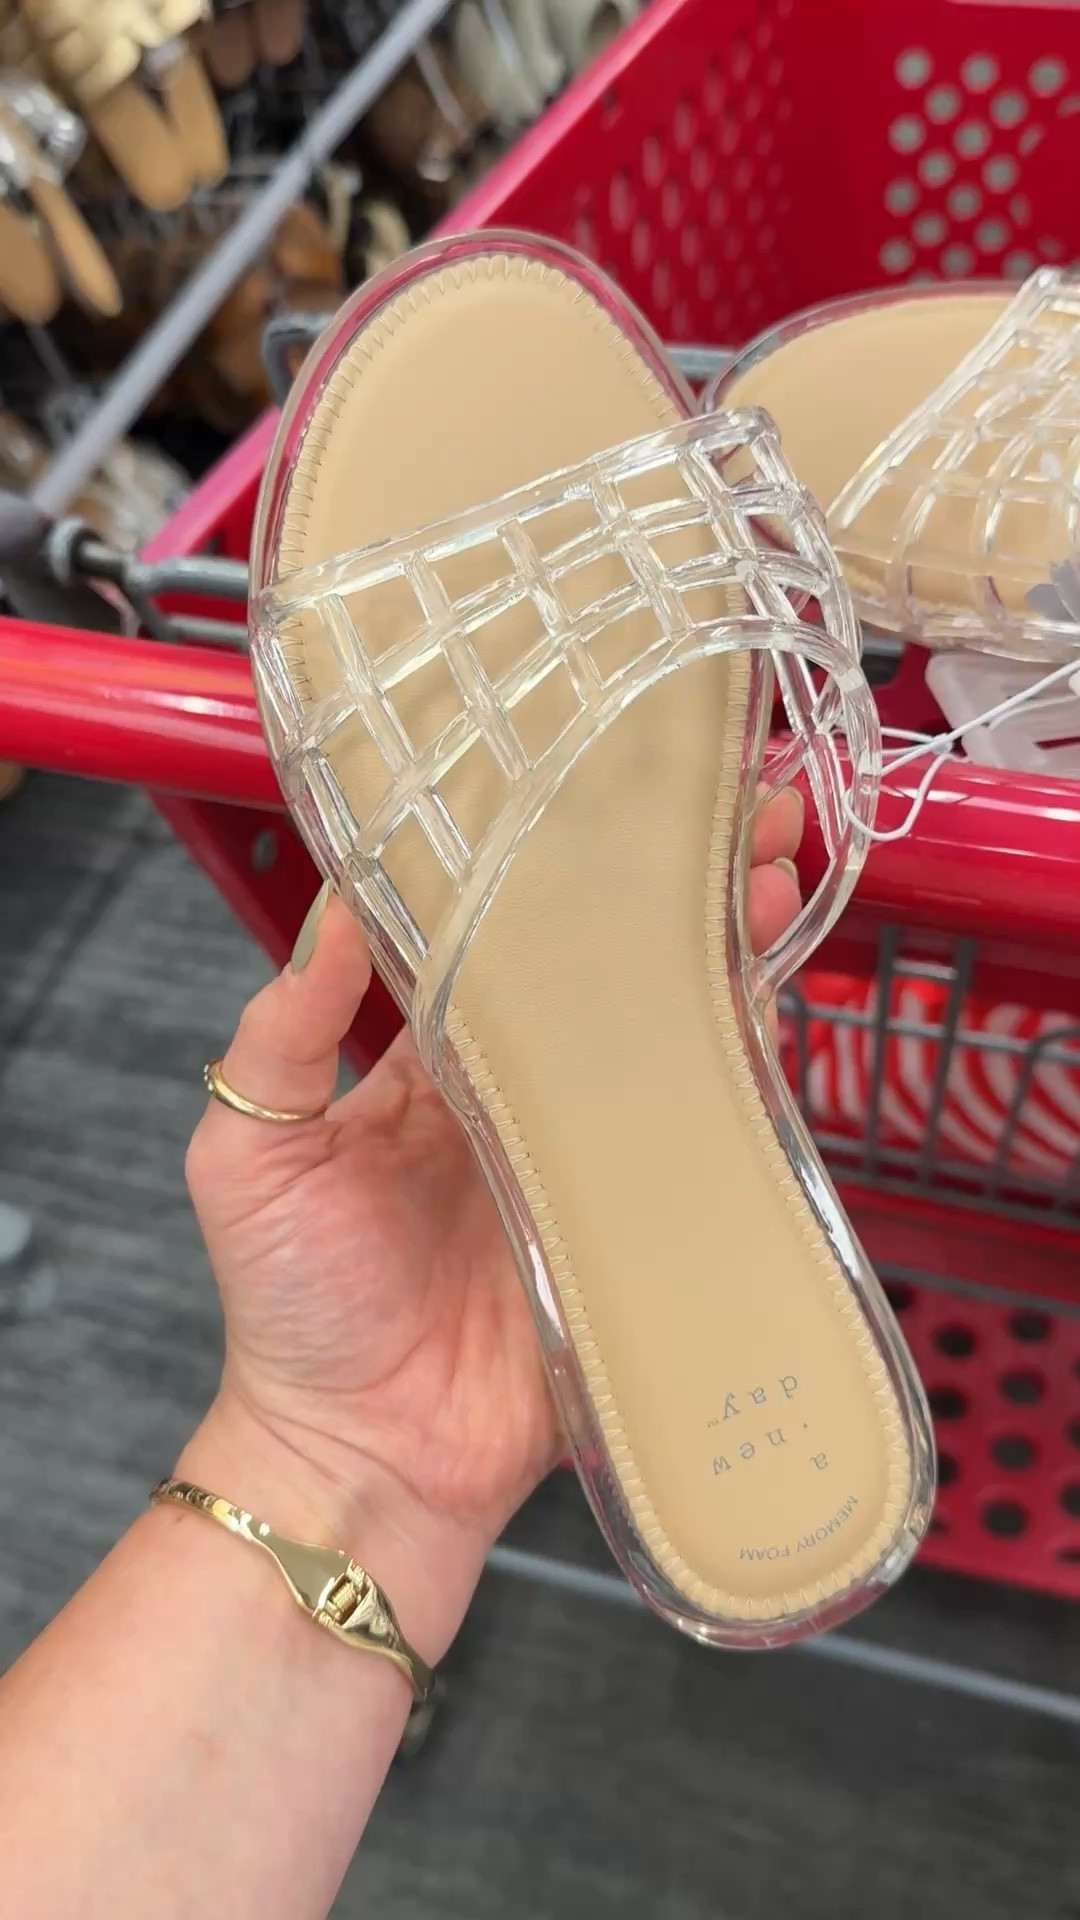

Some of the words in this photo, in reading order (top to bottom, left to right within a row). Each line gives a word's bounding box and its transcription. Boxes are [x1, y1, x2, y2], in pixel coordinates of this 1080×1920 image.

[712, 1428, 788, 1476] new
[809, 1452, 829, 1470] a
[796, 1495, 859, 1553] MEMORY
[739, 1546, 790, 1561] FOAM
